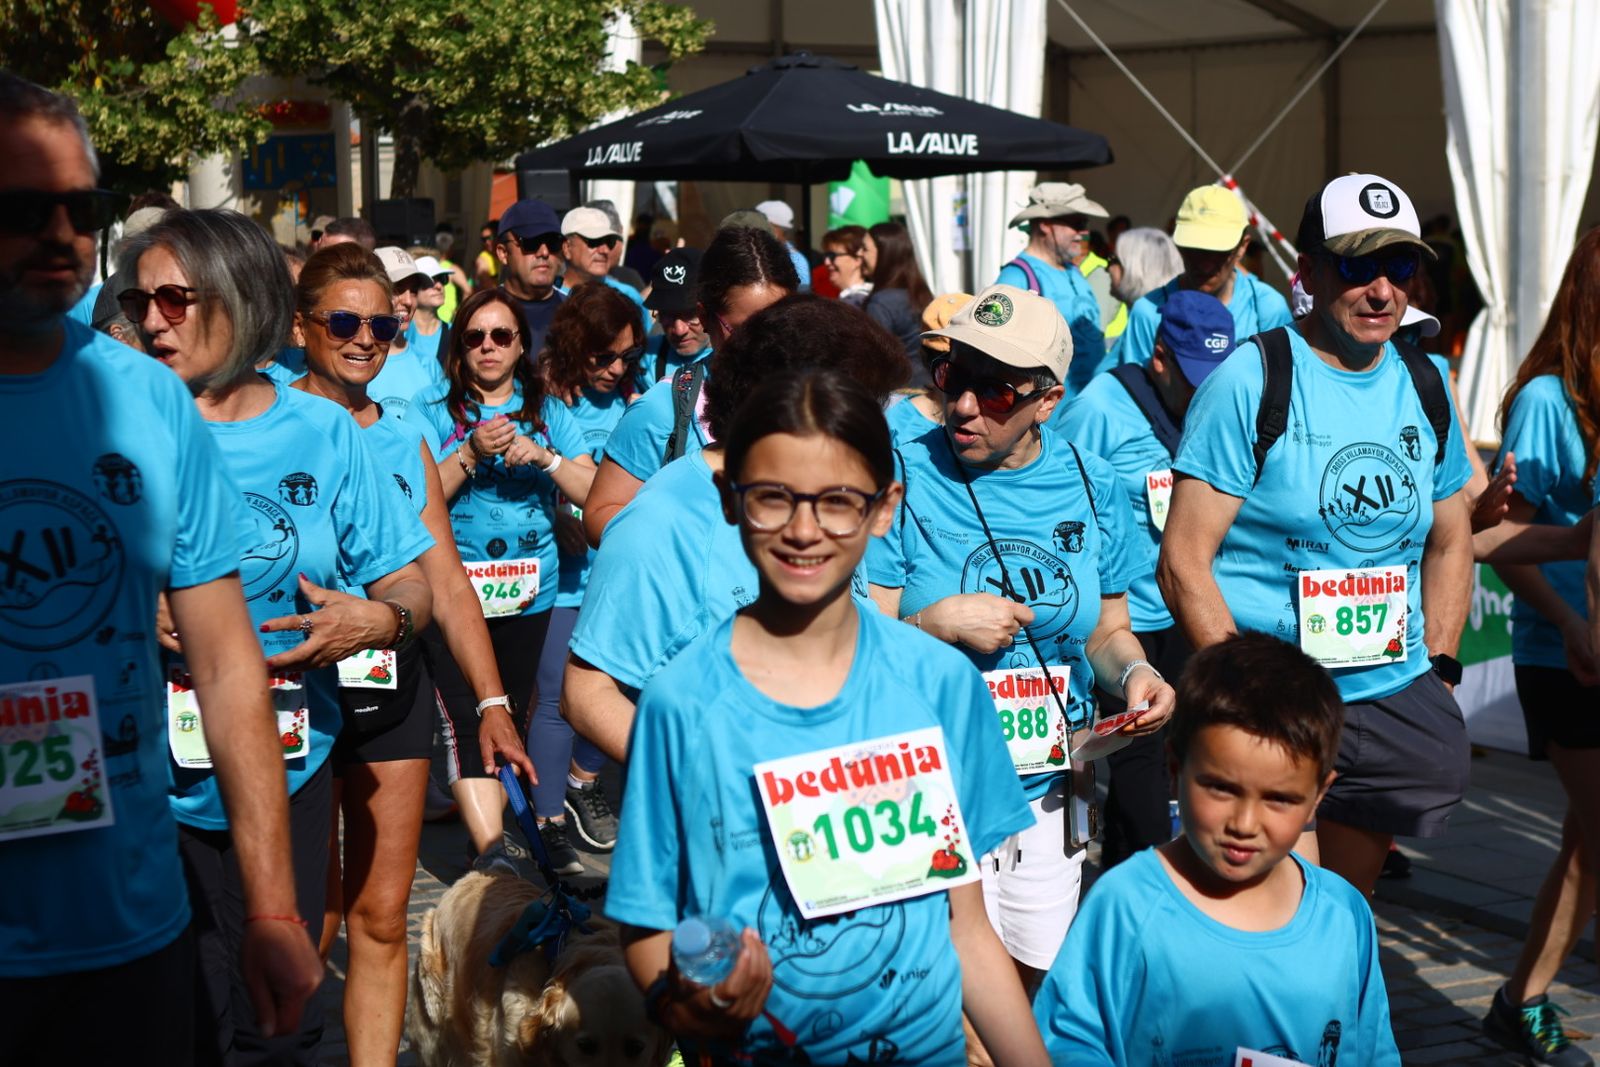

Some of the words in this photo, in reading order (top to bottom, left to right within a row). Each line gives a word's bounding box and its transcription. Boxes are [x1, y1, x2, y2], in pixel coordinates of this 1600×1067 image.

[584, 146, 602, 167] LA
[601, 141, 644, 164] SALVE
[887, 132, 914, 154] LA
[915, 132, 978, 156] SALVE
[1330, 455, 1347, 475] CROSS
[1344, 447, 1385, 460] VILLAMAYOR
[1342, 475, 1395, 513] XII
[252, 498, 281, 519] ASPACE
[984, 544, 1031, 557] VIAMAYOR
[1031, 549, 1059, 570] ASPACE
[482, 581, 521, 601] 946
[1302, 571, 1405, 598] bedunia
[1336, 603, 1388, 636] 857
[998, 706, 1048, 741] 888
[0, 735, 75, 789] 25
[763, 742, 942, 807] bedunia
[812, 791, 937, 860] 1034
